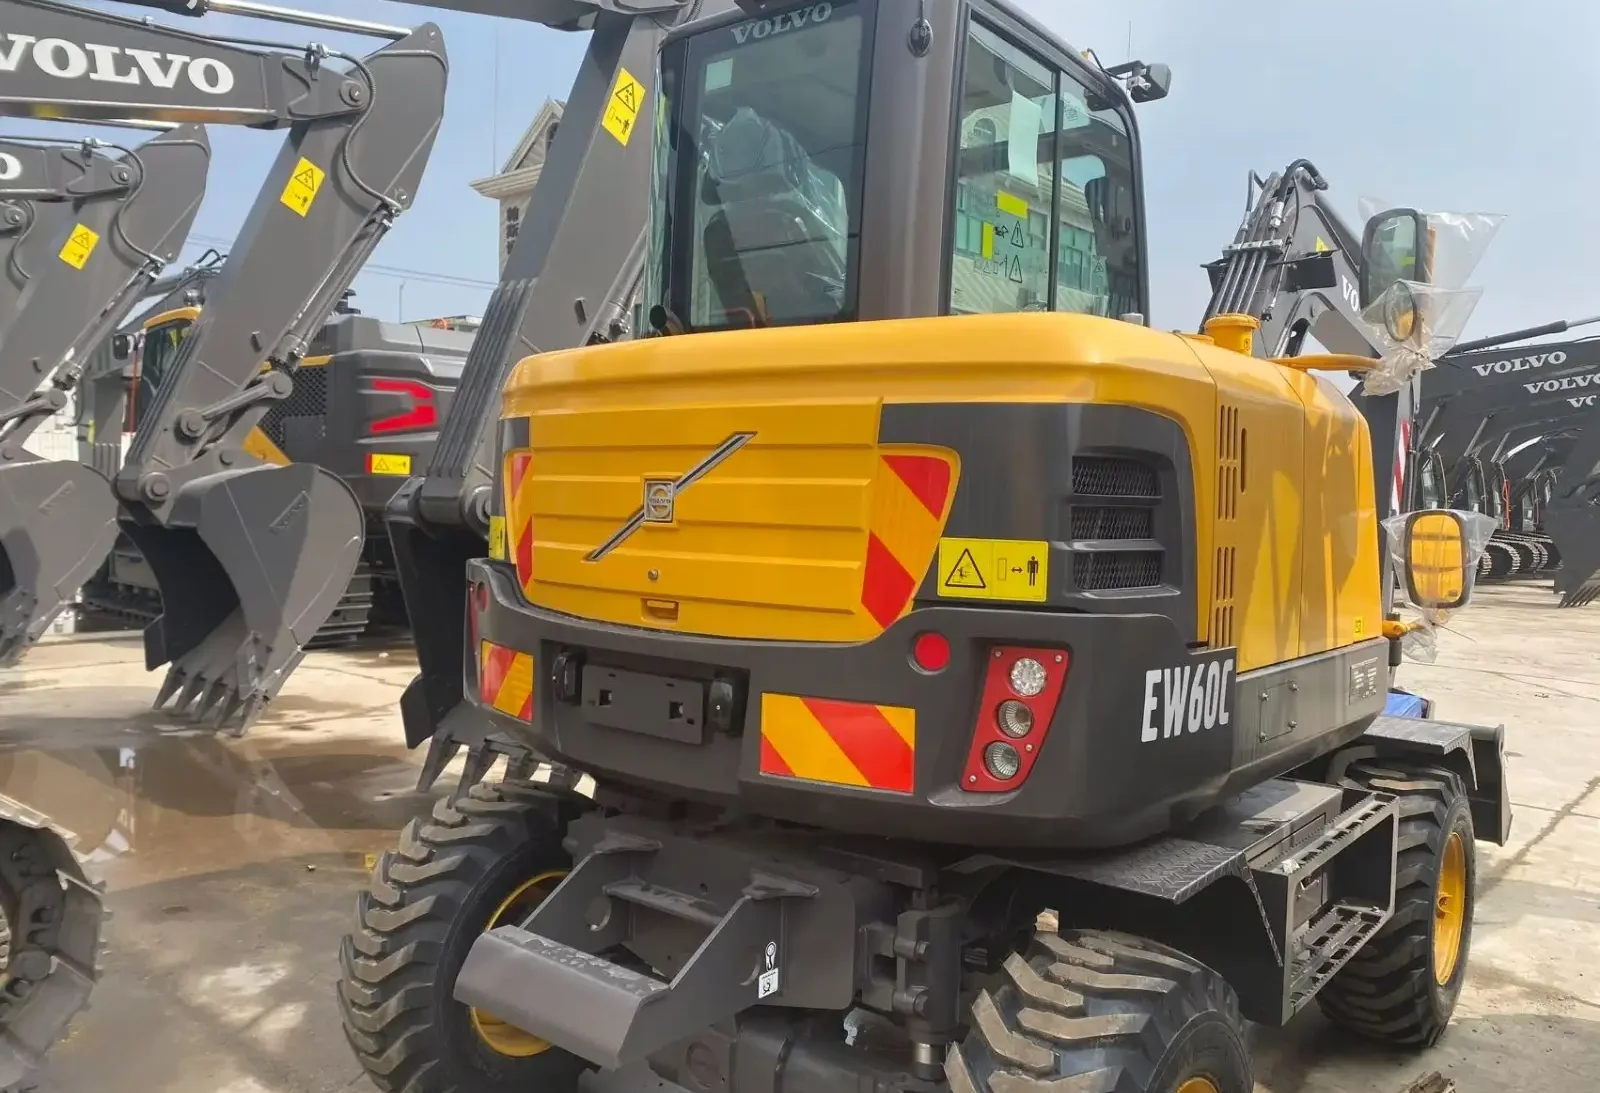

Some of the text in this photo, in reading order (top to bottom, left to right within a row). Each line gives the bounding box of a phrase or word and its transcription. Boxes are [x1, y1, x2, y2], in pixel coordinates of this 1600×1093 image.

[731, 2, 832, 44] VOLVO
[1472, 351, 1567, 377] VOLVO
[1141, 659, 1234, 743] EW60C
